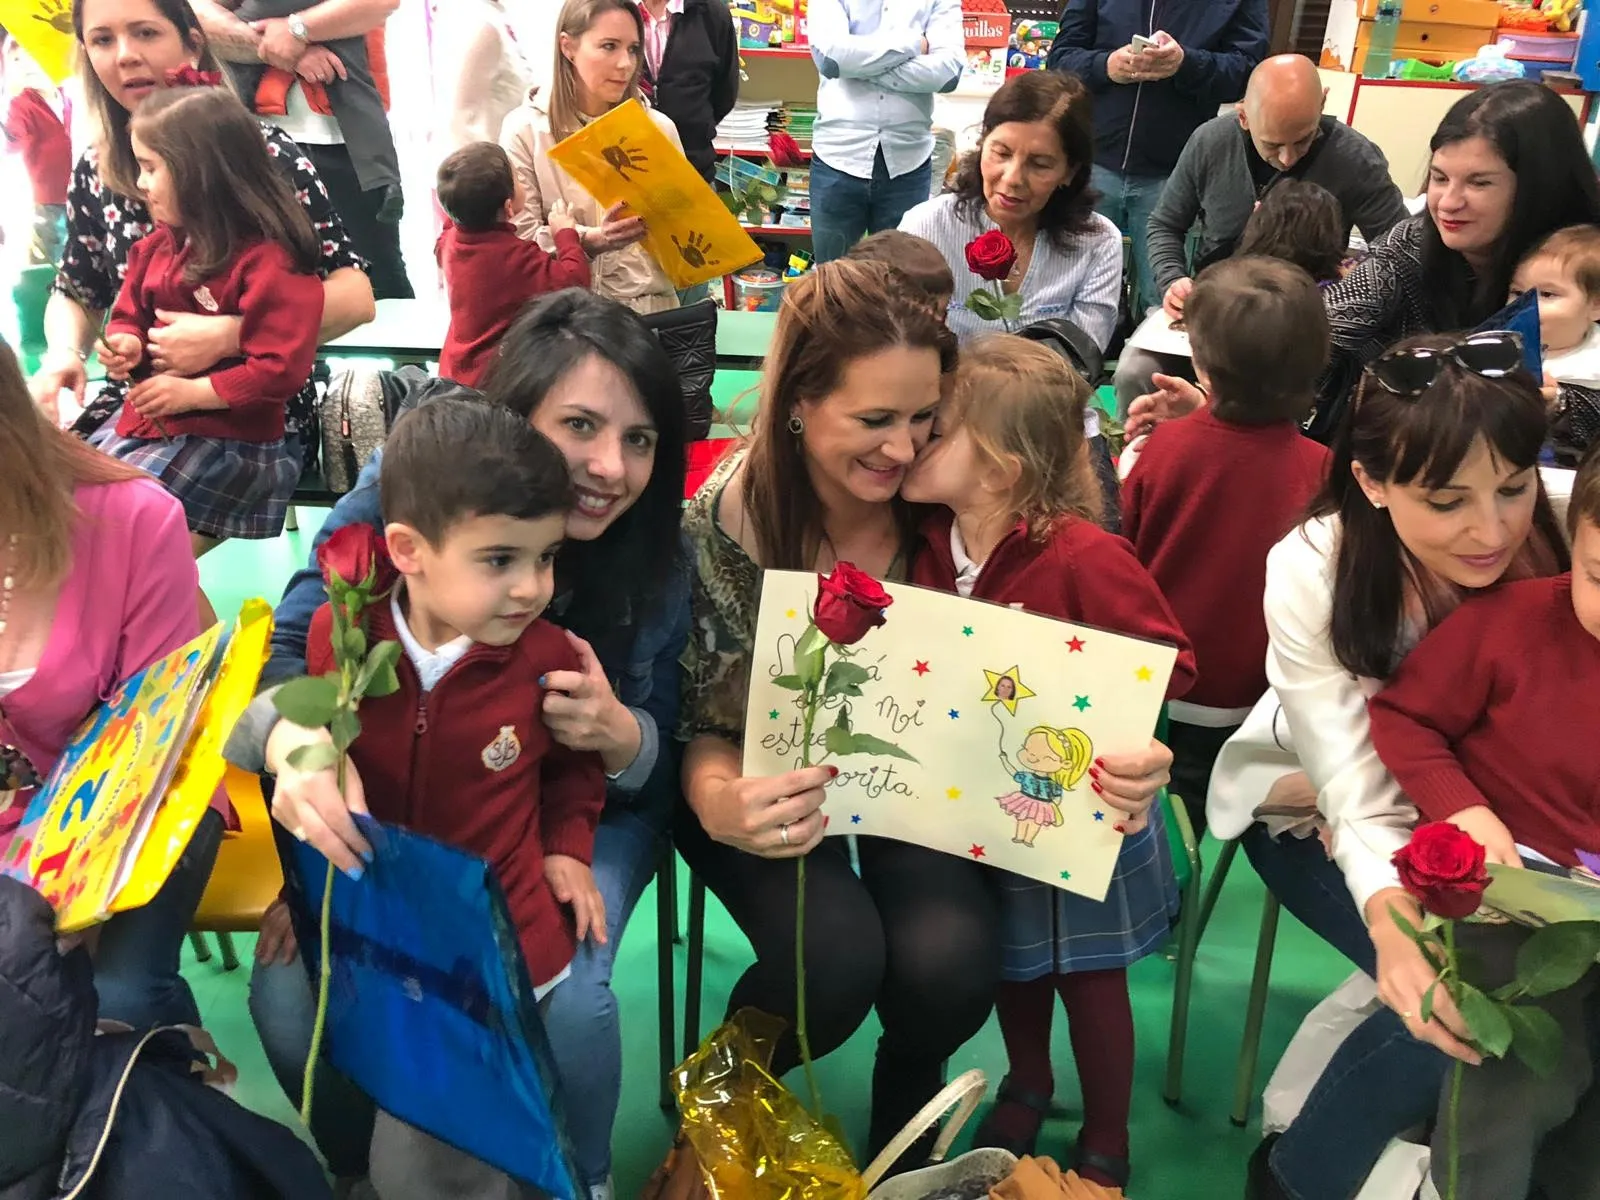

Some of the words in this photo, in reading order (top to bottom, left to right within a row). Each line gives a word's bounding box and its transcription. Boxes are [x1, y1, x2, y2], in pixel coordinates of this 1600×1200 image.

[963, 20, 1004, 38] uillas
[992, 59, 1003, 73] 5
[32, 837, 78, 889] 1
[58, 768, 111, 832] 2
[91, 706, 140, 766] 3
